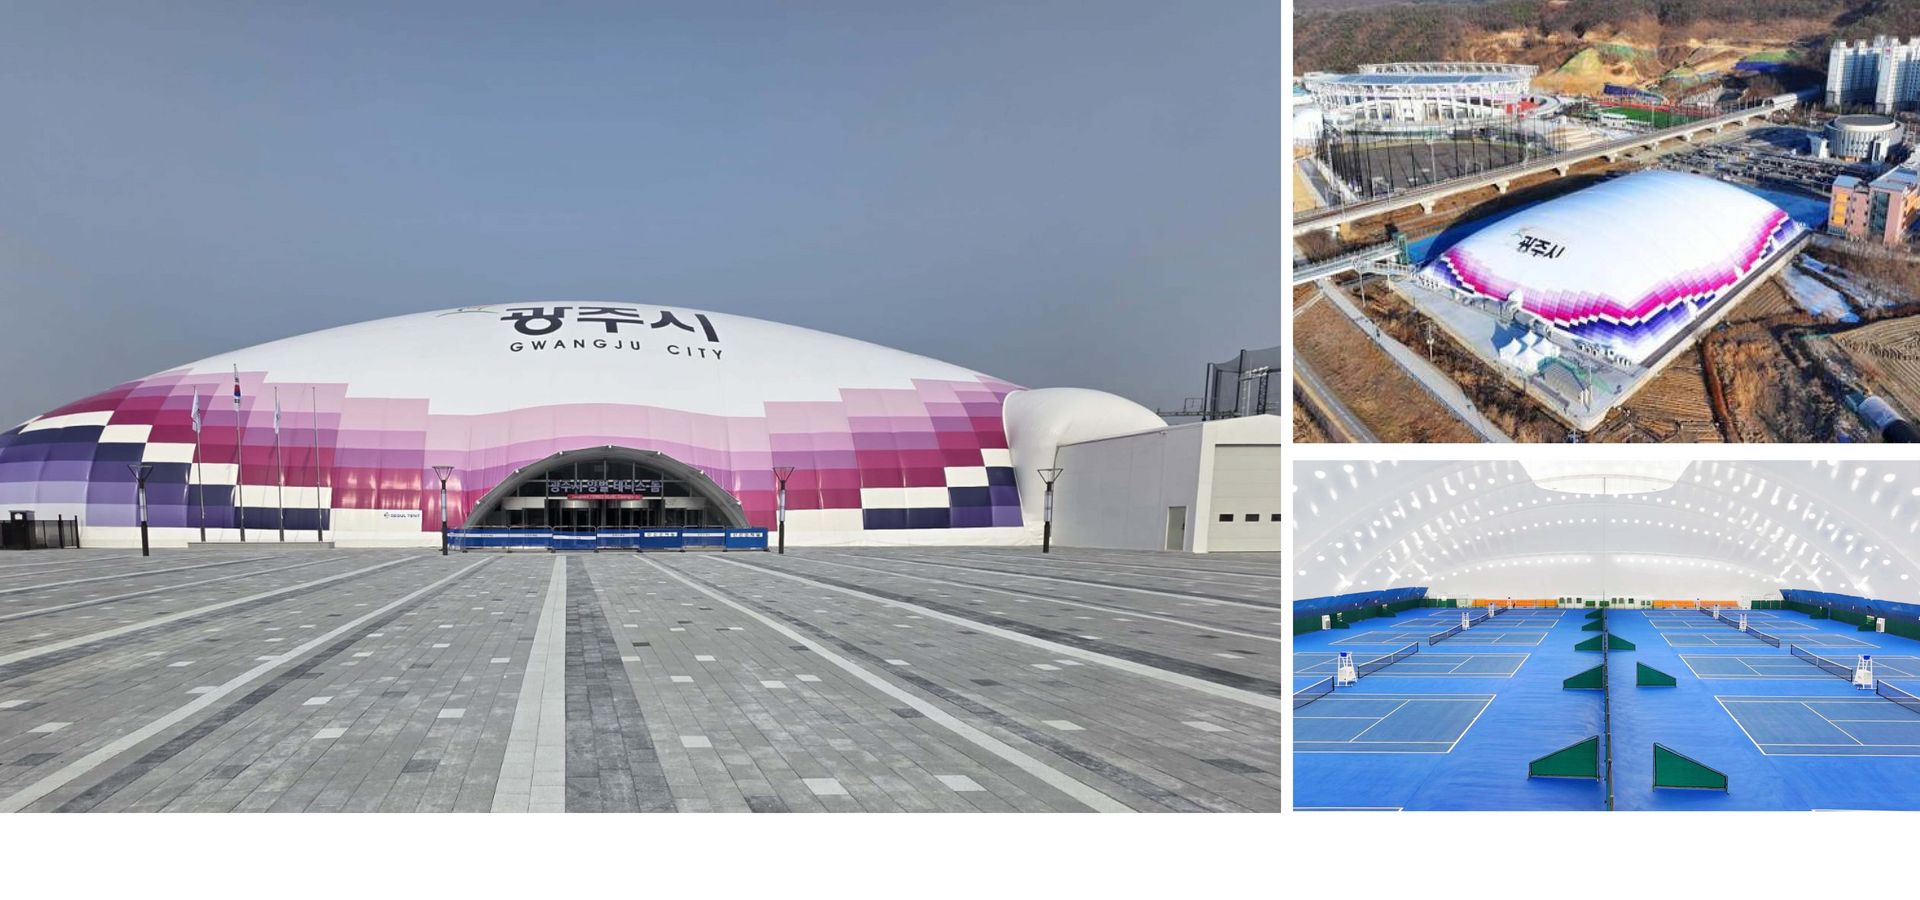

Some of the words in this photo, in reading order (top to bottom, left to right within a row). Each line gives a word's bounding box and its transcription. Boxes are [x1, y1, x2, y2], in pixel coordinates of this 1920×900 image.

[1517, 236, 1565, 258] 광주시
[500, 306, 720, 343] 광주시
[510, 338, 641, 352] GWANGJU
[667, 344, 723, 360] CITY
[550, 480, 583, 493] 광주시
[614, 480, 647, 493] 테니스
